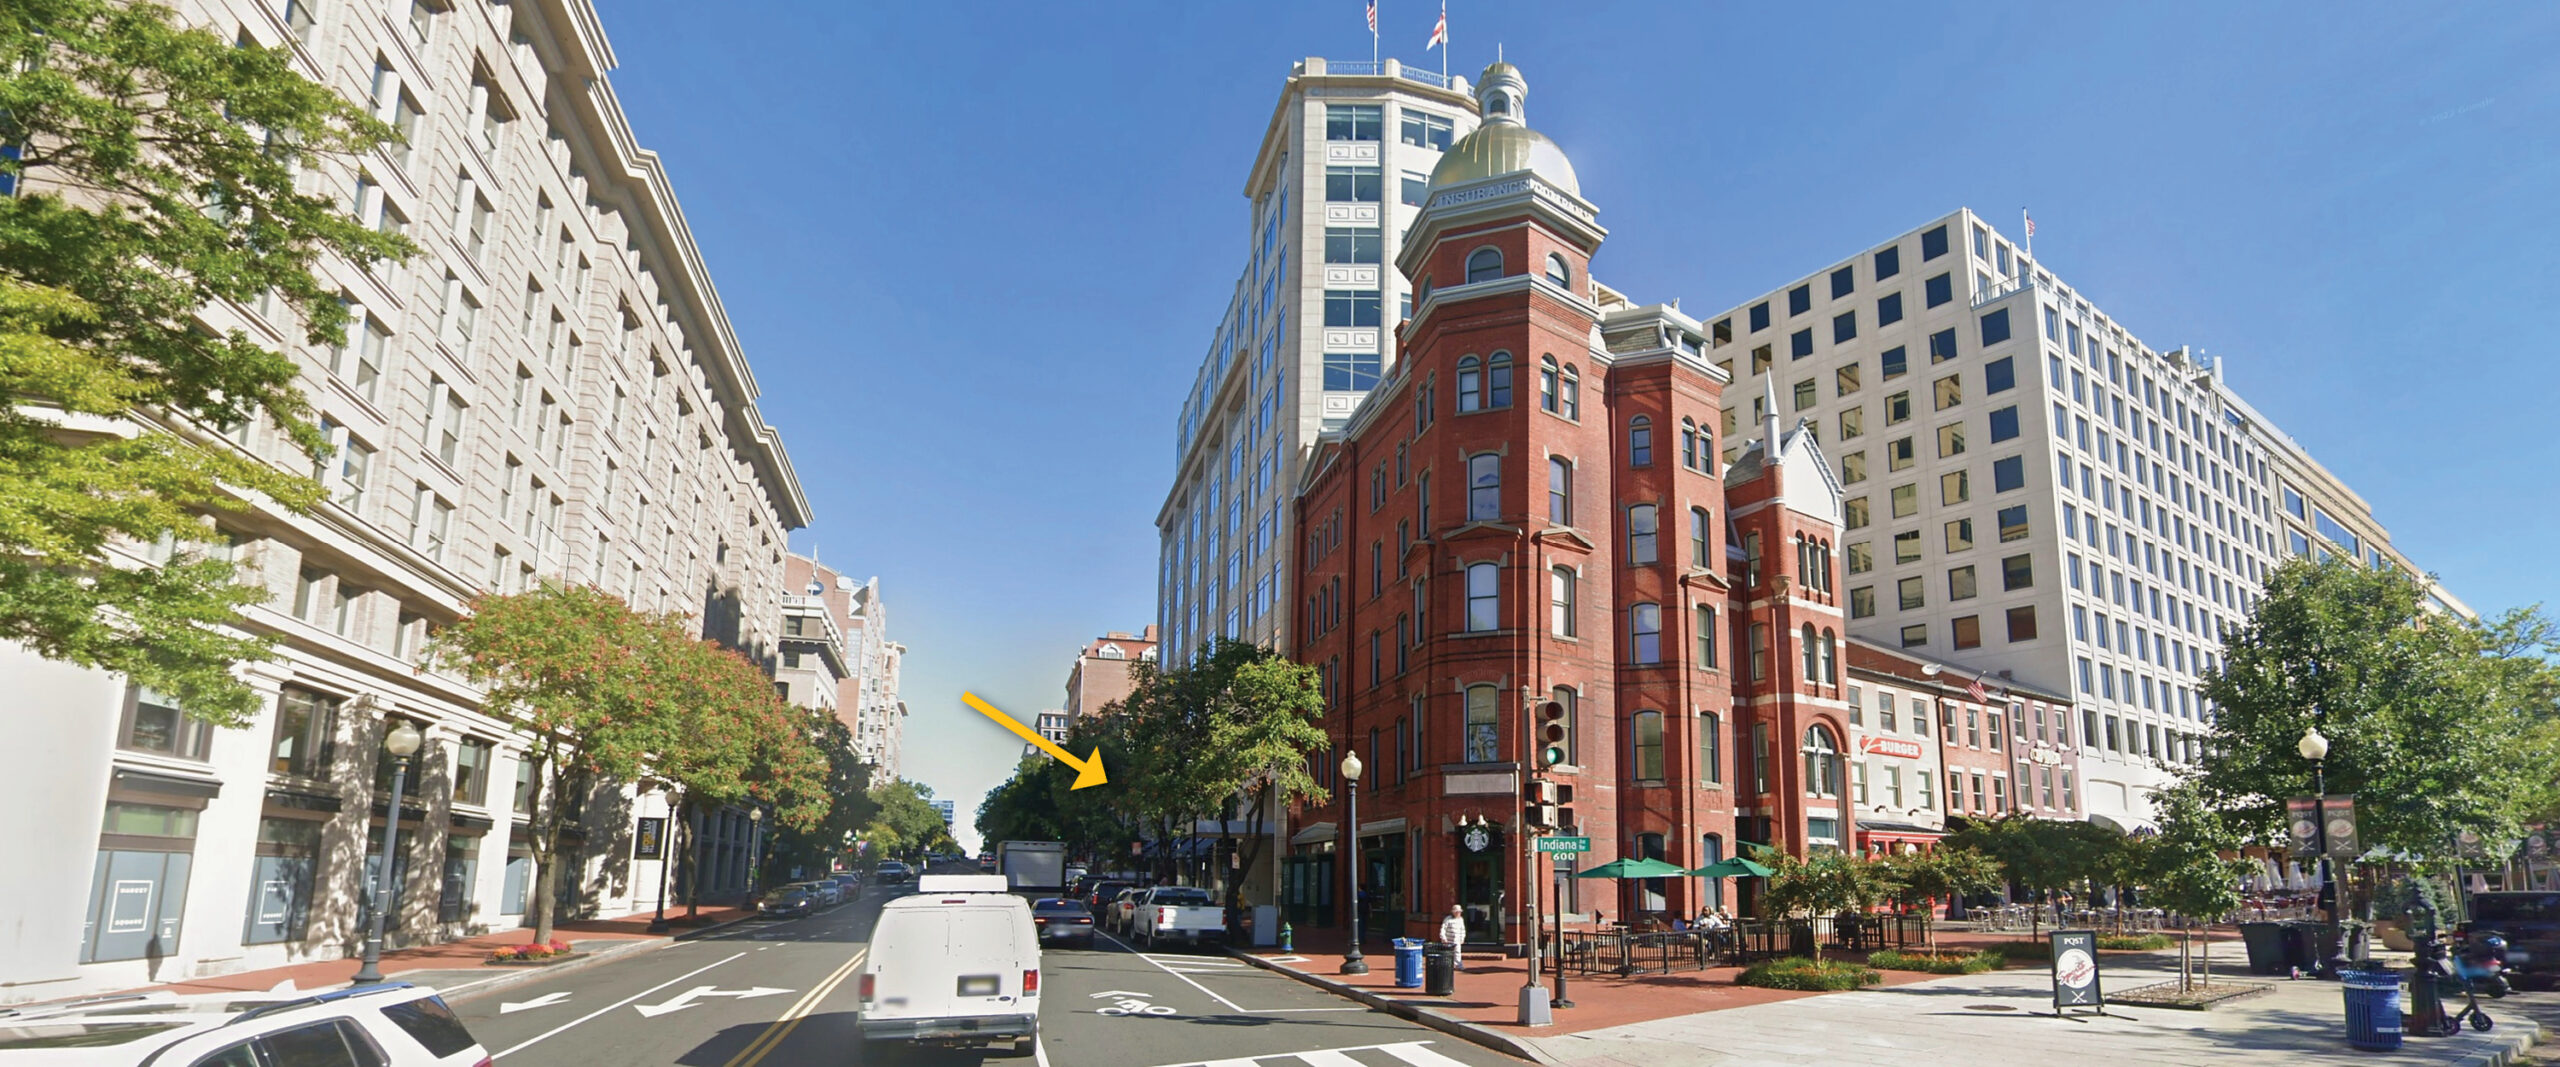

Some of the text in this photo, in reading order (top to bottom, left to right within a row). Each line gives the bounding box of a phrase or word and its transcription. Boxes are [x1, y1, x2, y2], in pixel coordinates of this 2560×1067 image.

[1438, 179, 1529, 207] INSURANCE
[1880, 740, 1919, 756] BURGER
[1540, 839, 1577, 850] Indiana
[1553, 853, 1576, 861] 600
